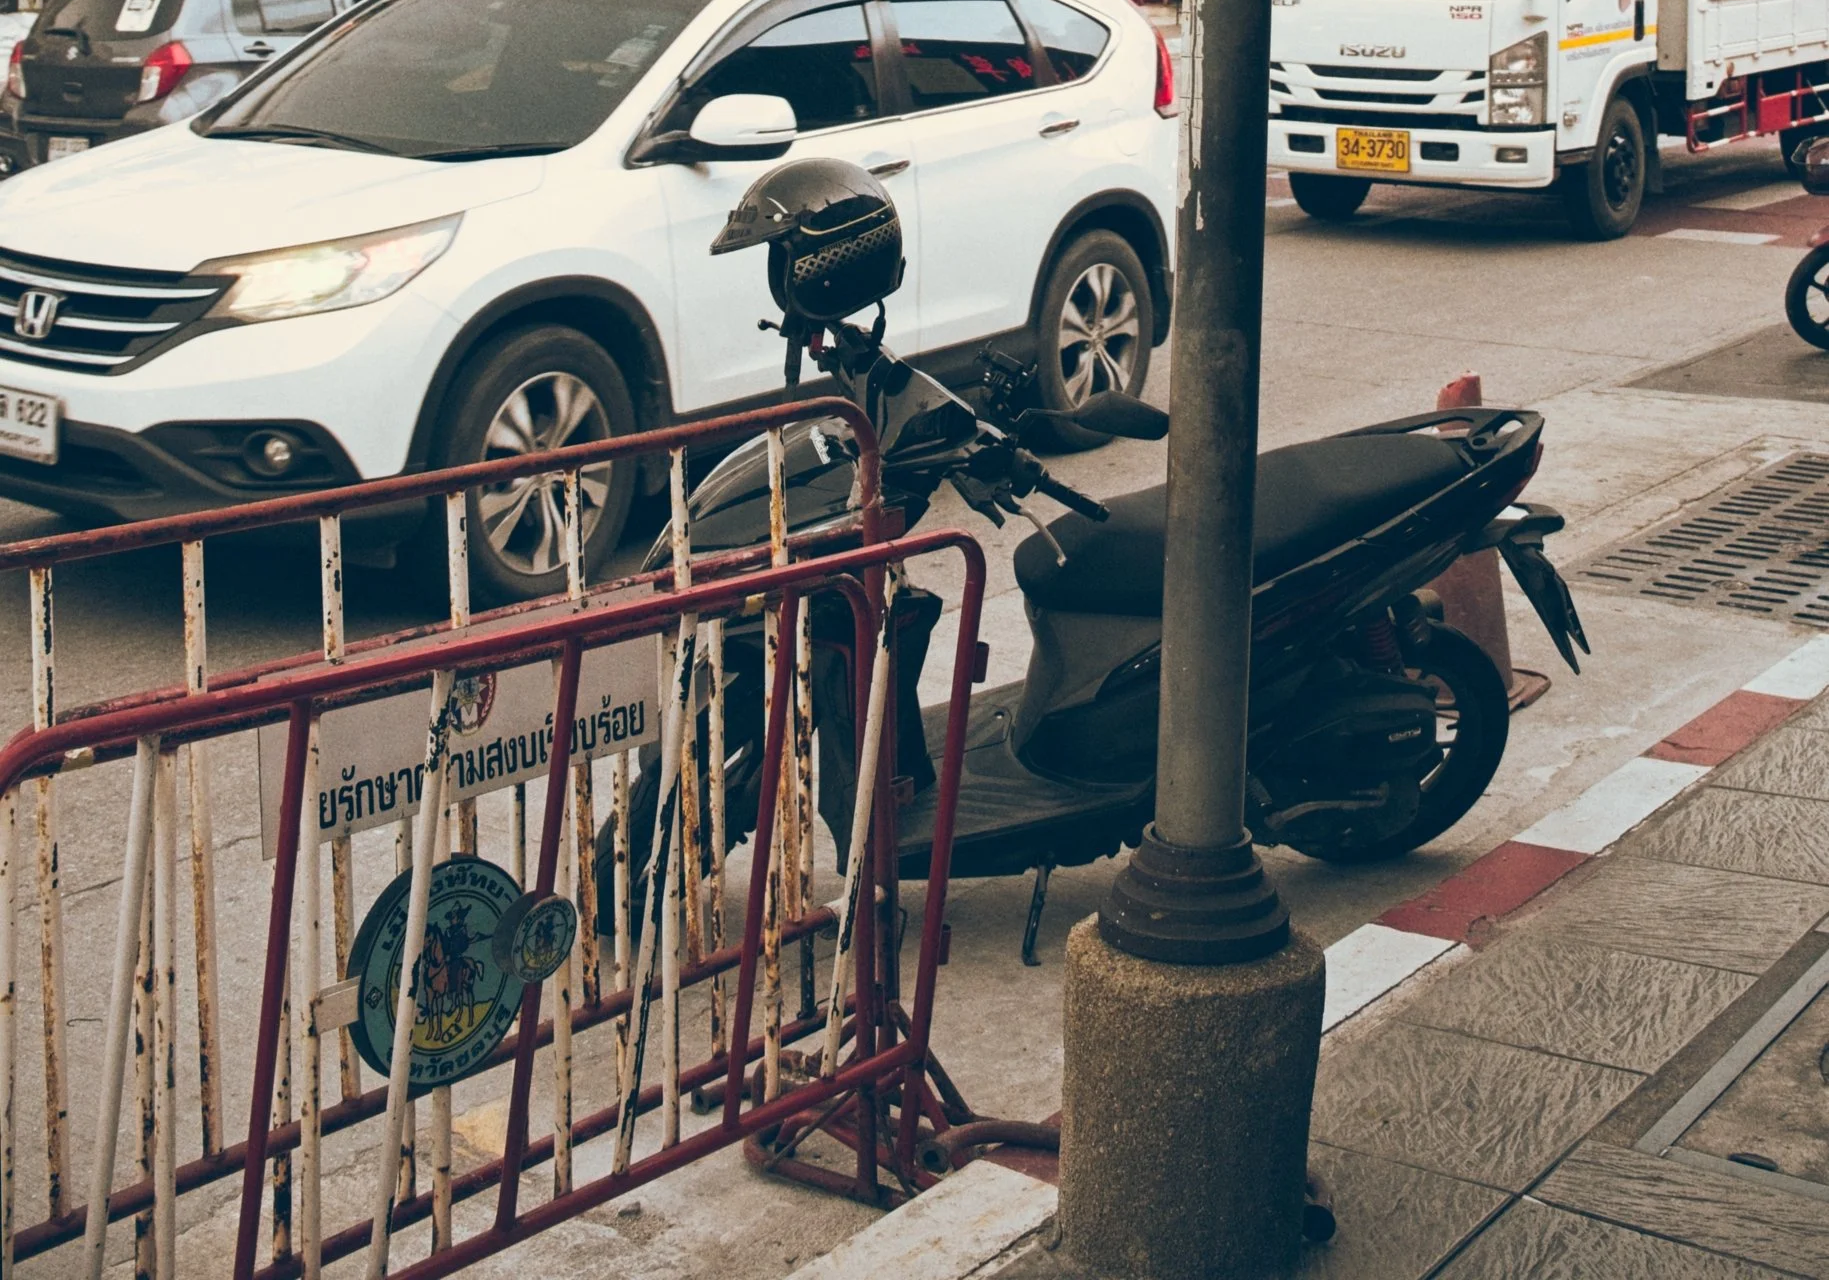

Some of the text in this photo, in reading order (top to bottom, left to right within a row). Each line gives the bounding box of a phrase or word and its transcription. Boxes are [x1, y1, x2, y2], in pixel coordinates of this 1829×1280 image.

[1449, 5, 1483, 13] NPR
[1339, 44, 1406, 58] ISUZU
[1340, 137, 1406, 160] 34-3730
